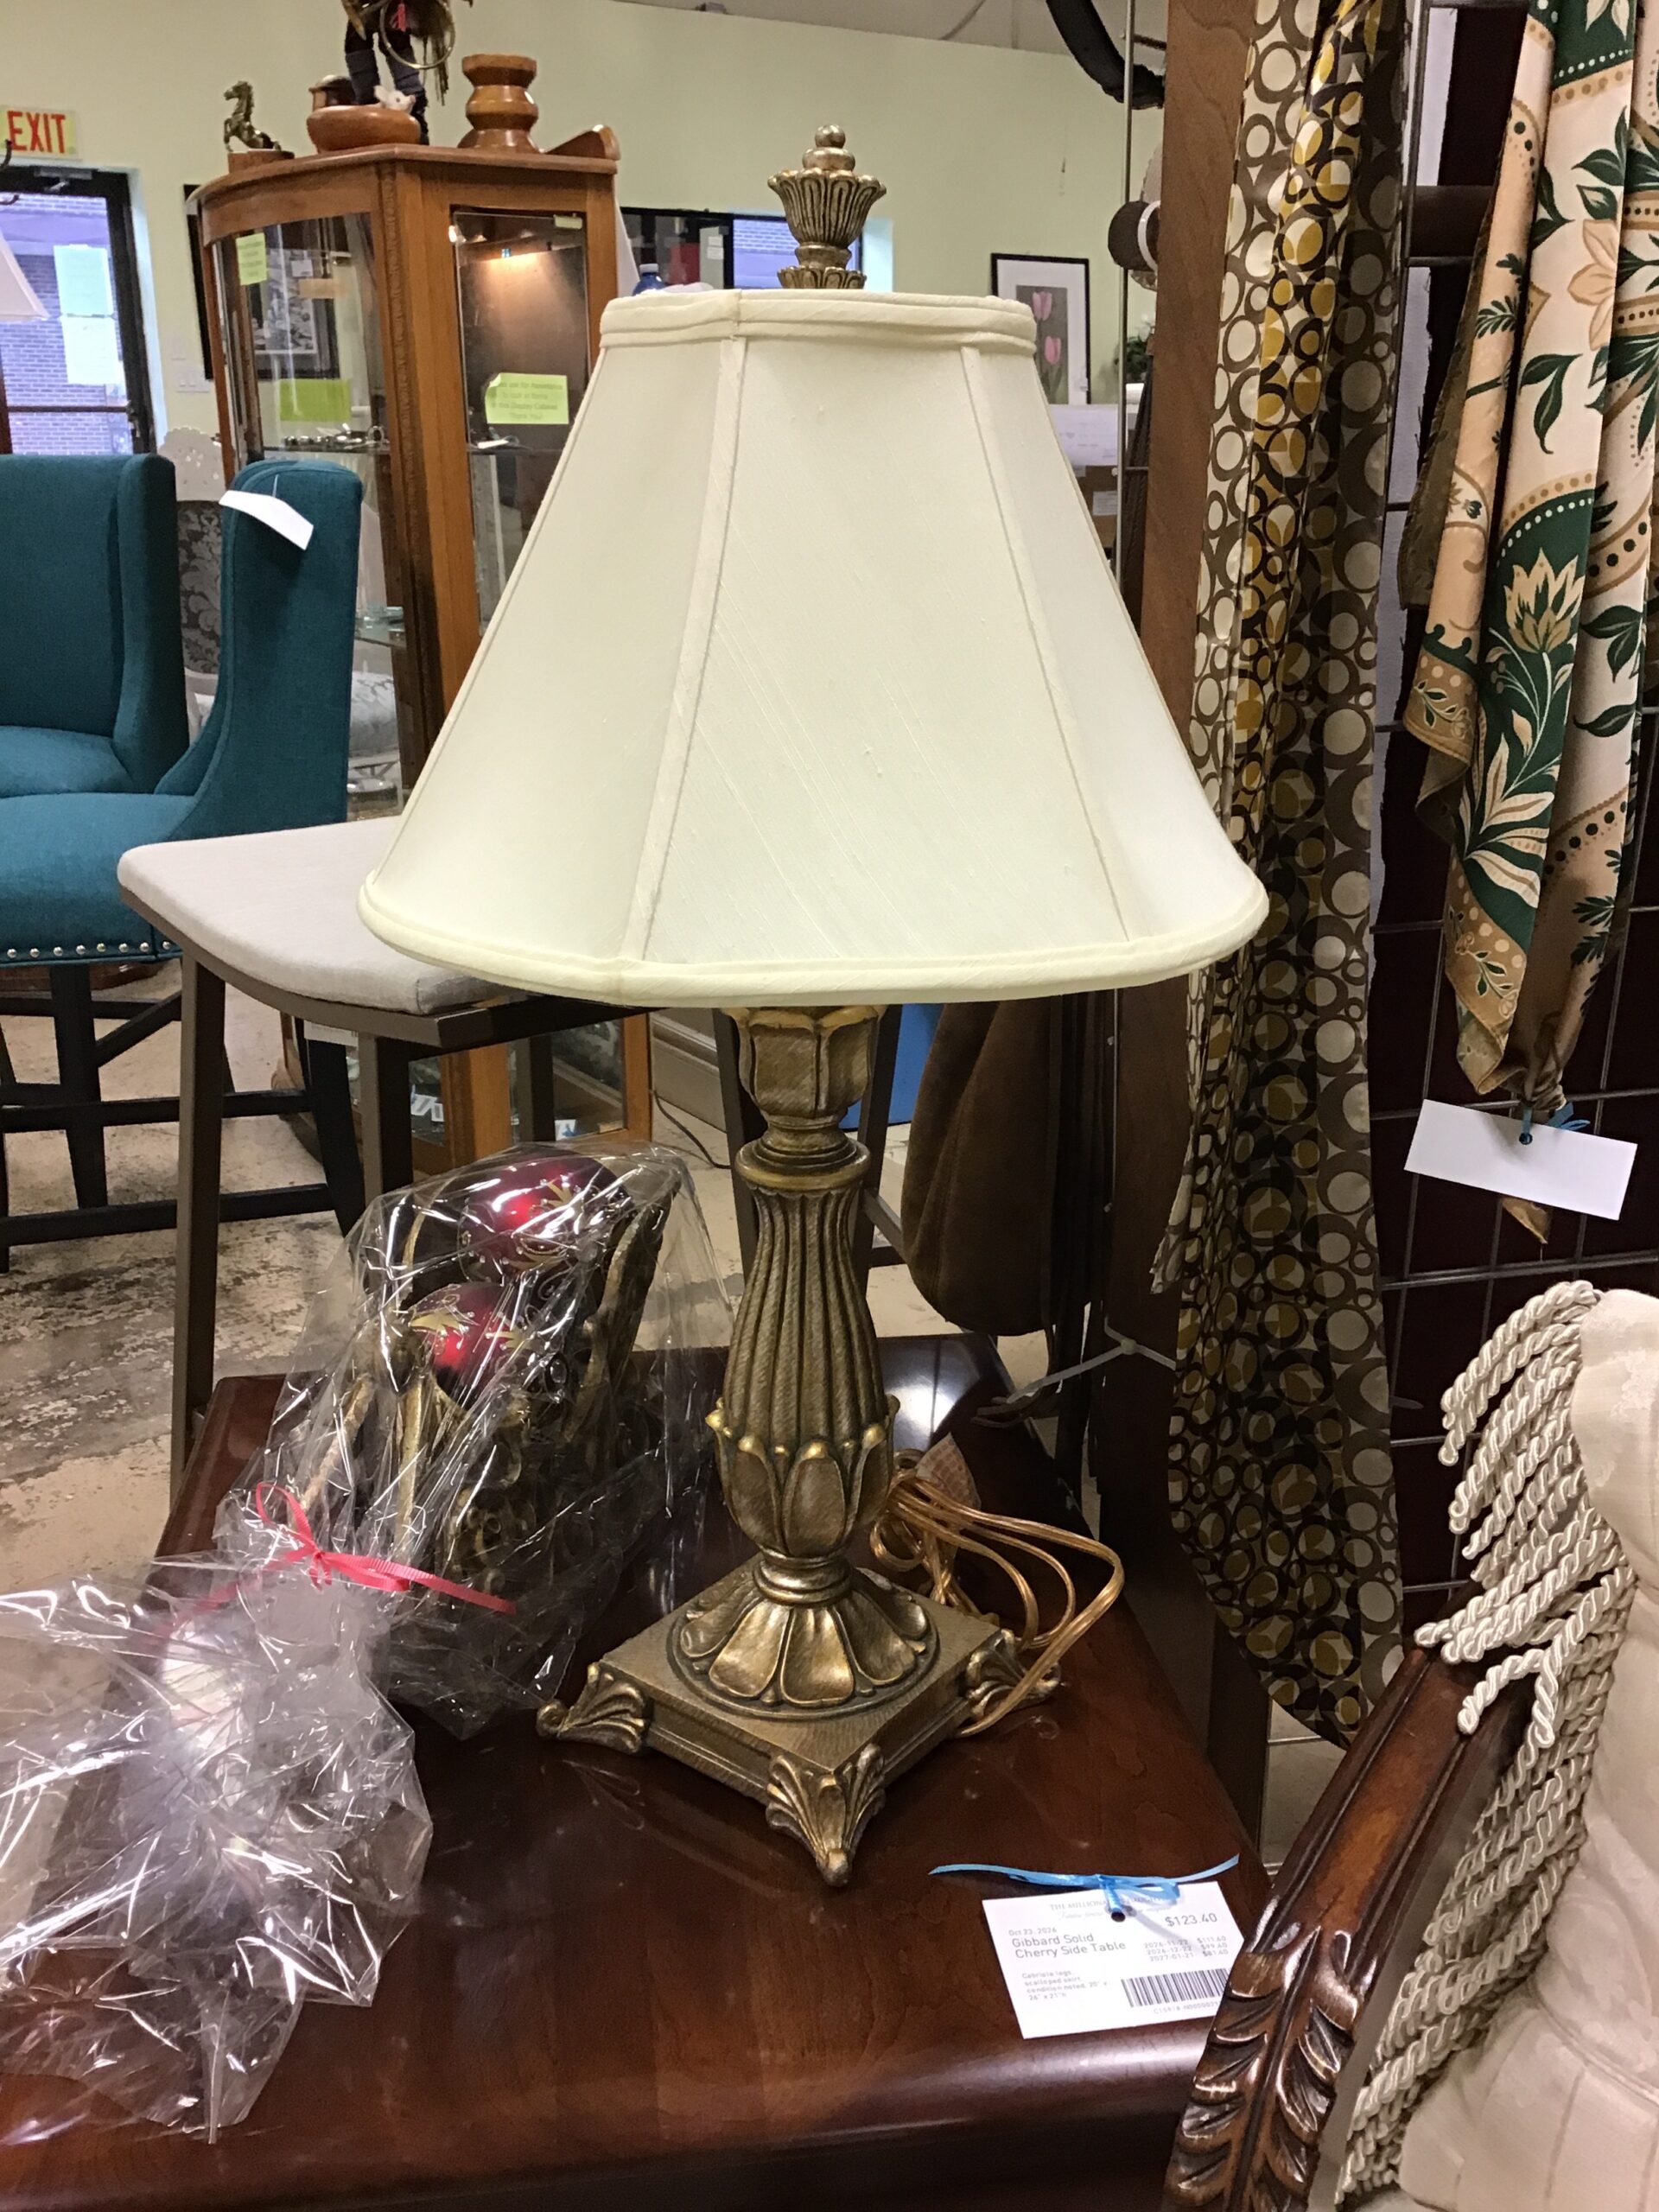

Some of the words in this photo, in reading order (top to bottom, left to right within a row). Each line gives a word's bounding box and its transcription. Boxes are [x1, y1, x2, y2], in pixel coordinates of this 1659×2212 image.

[7, 111, 66, 153] EXIT
[1165, 1913, 1217, 1927] $123.40
[1012, 1936, 1060, 1948] Gibbard
[1064, 1933, 1094, 1943] Solid
[1015, 1948, 1058, 1958] Cherry
[1061, 1946, 1087, 1955] Side
[1090, 1942, 1126, 1952] Table
